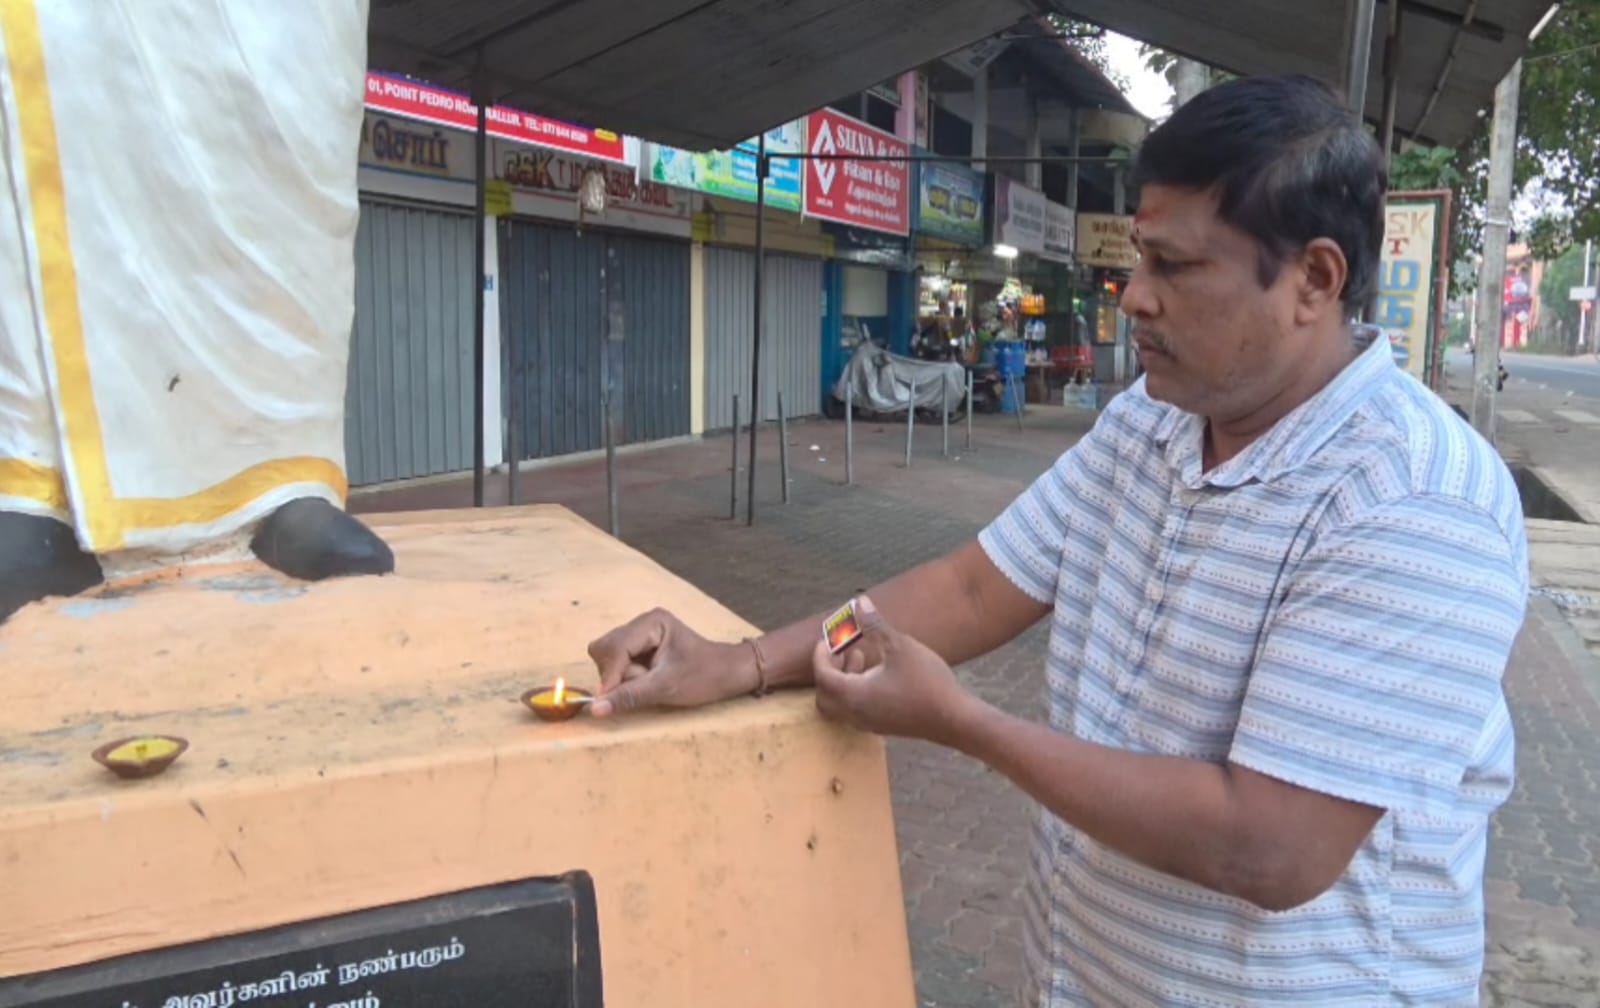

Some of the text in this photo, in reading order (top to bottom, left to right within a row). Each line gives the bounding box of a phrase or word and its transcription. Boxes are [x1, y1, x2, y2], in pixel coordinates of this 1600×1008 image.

[384, 82, 419, 102] POINT
[419, 91, 455, 110] PEDRO
[836, 124, 874, 158] SILVA
[889, 144, 905, 170] CO
[338, 936, 466, 985] நண்பரும்
